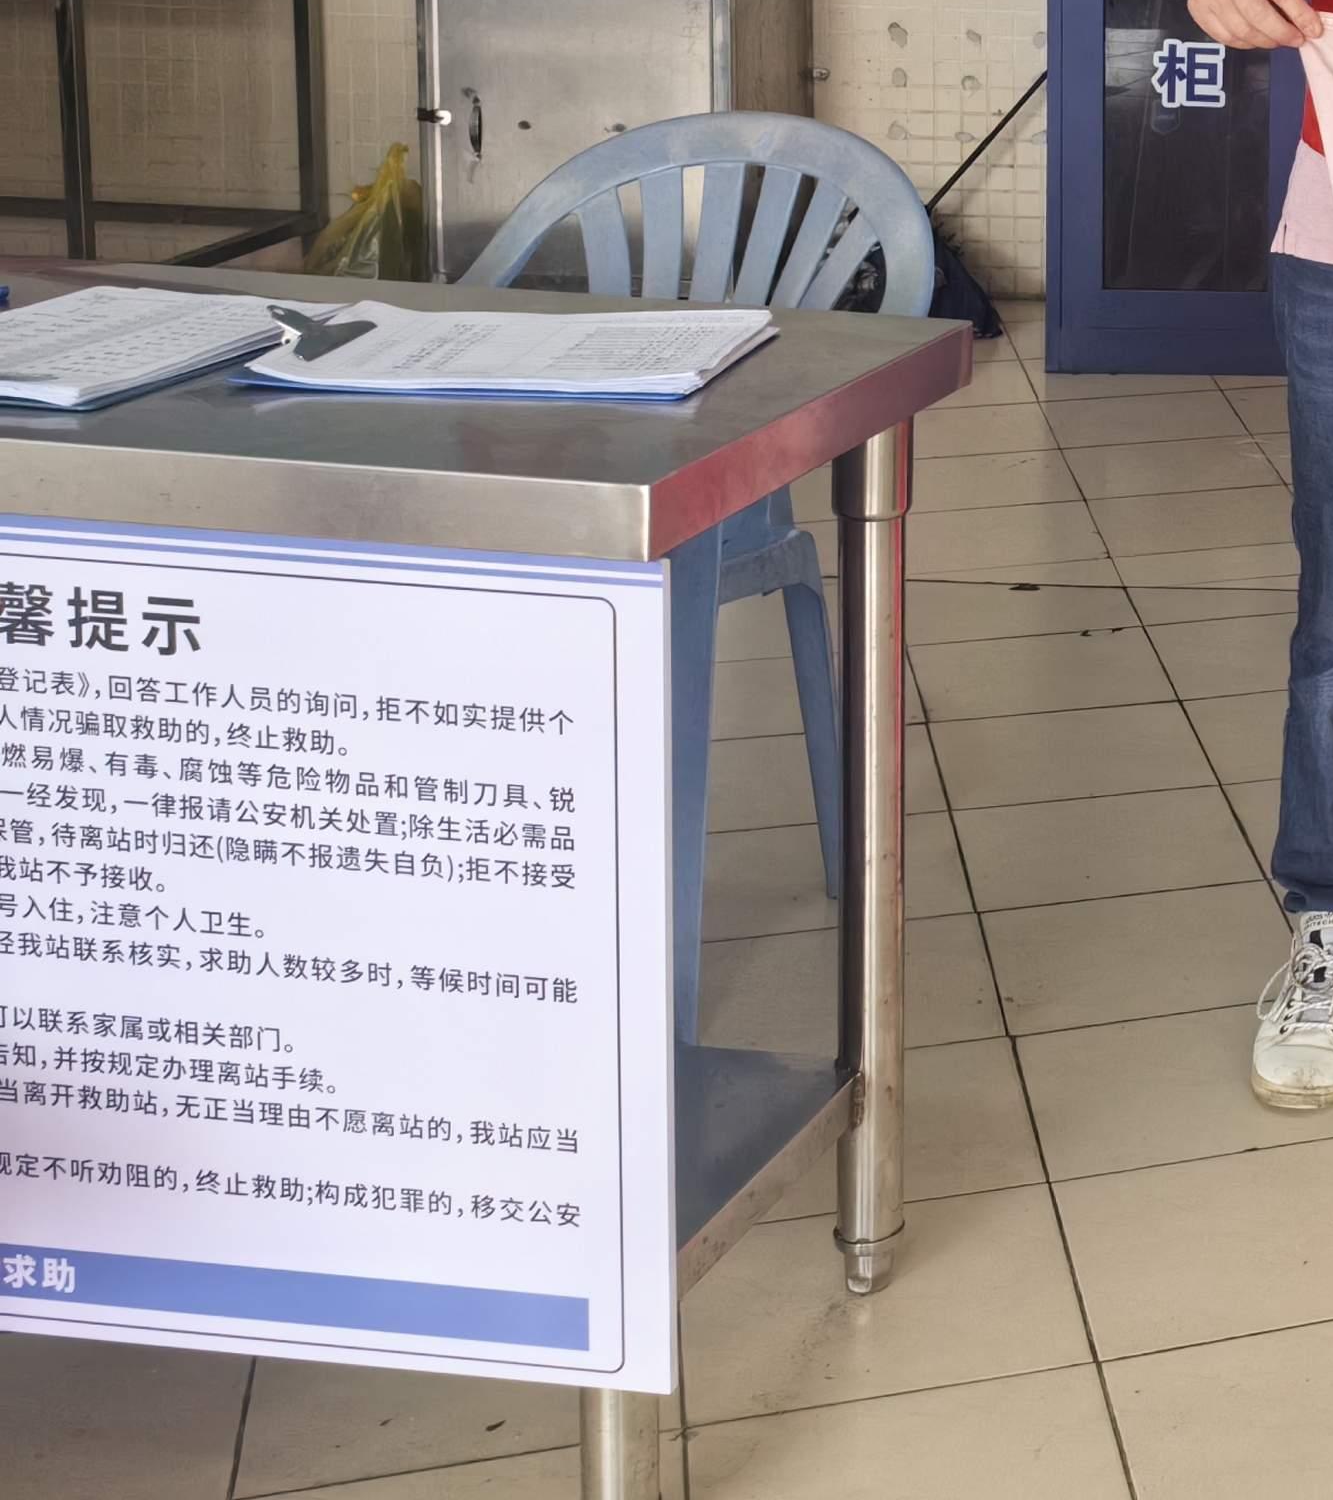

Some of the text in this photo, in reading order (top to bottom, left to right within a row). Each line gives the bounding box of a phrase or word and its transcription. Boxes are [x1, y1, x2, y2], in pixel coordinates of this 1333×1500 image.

[0, 581, 201, 656] 馨提示
[0, 818, 576, 889] 管，待离站时归还(隐瞒不报遗失自负);拒不接受
[0, 1042, 336, 1095] 知，并按规定办理离站手续。
[3, 1254, 76, 1293] 求助
